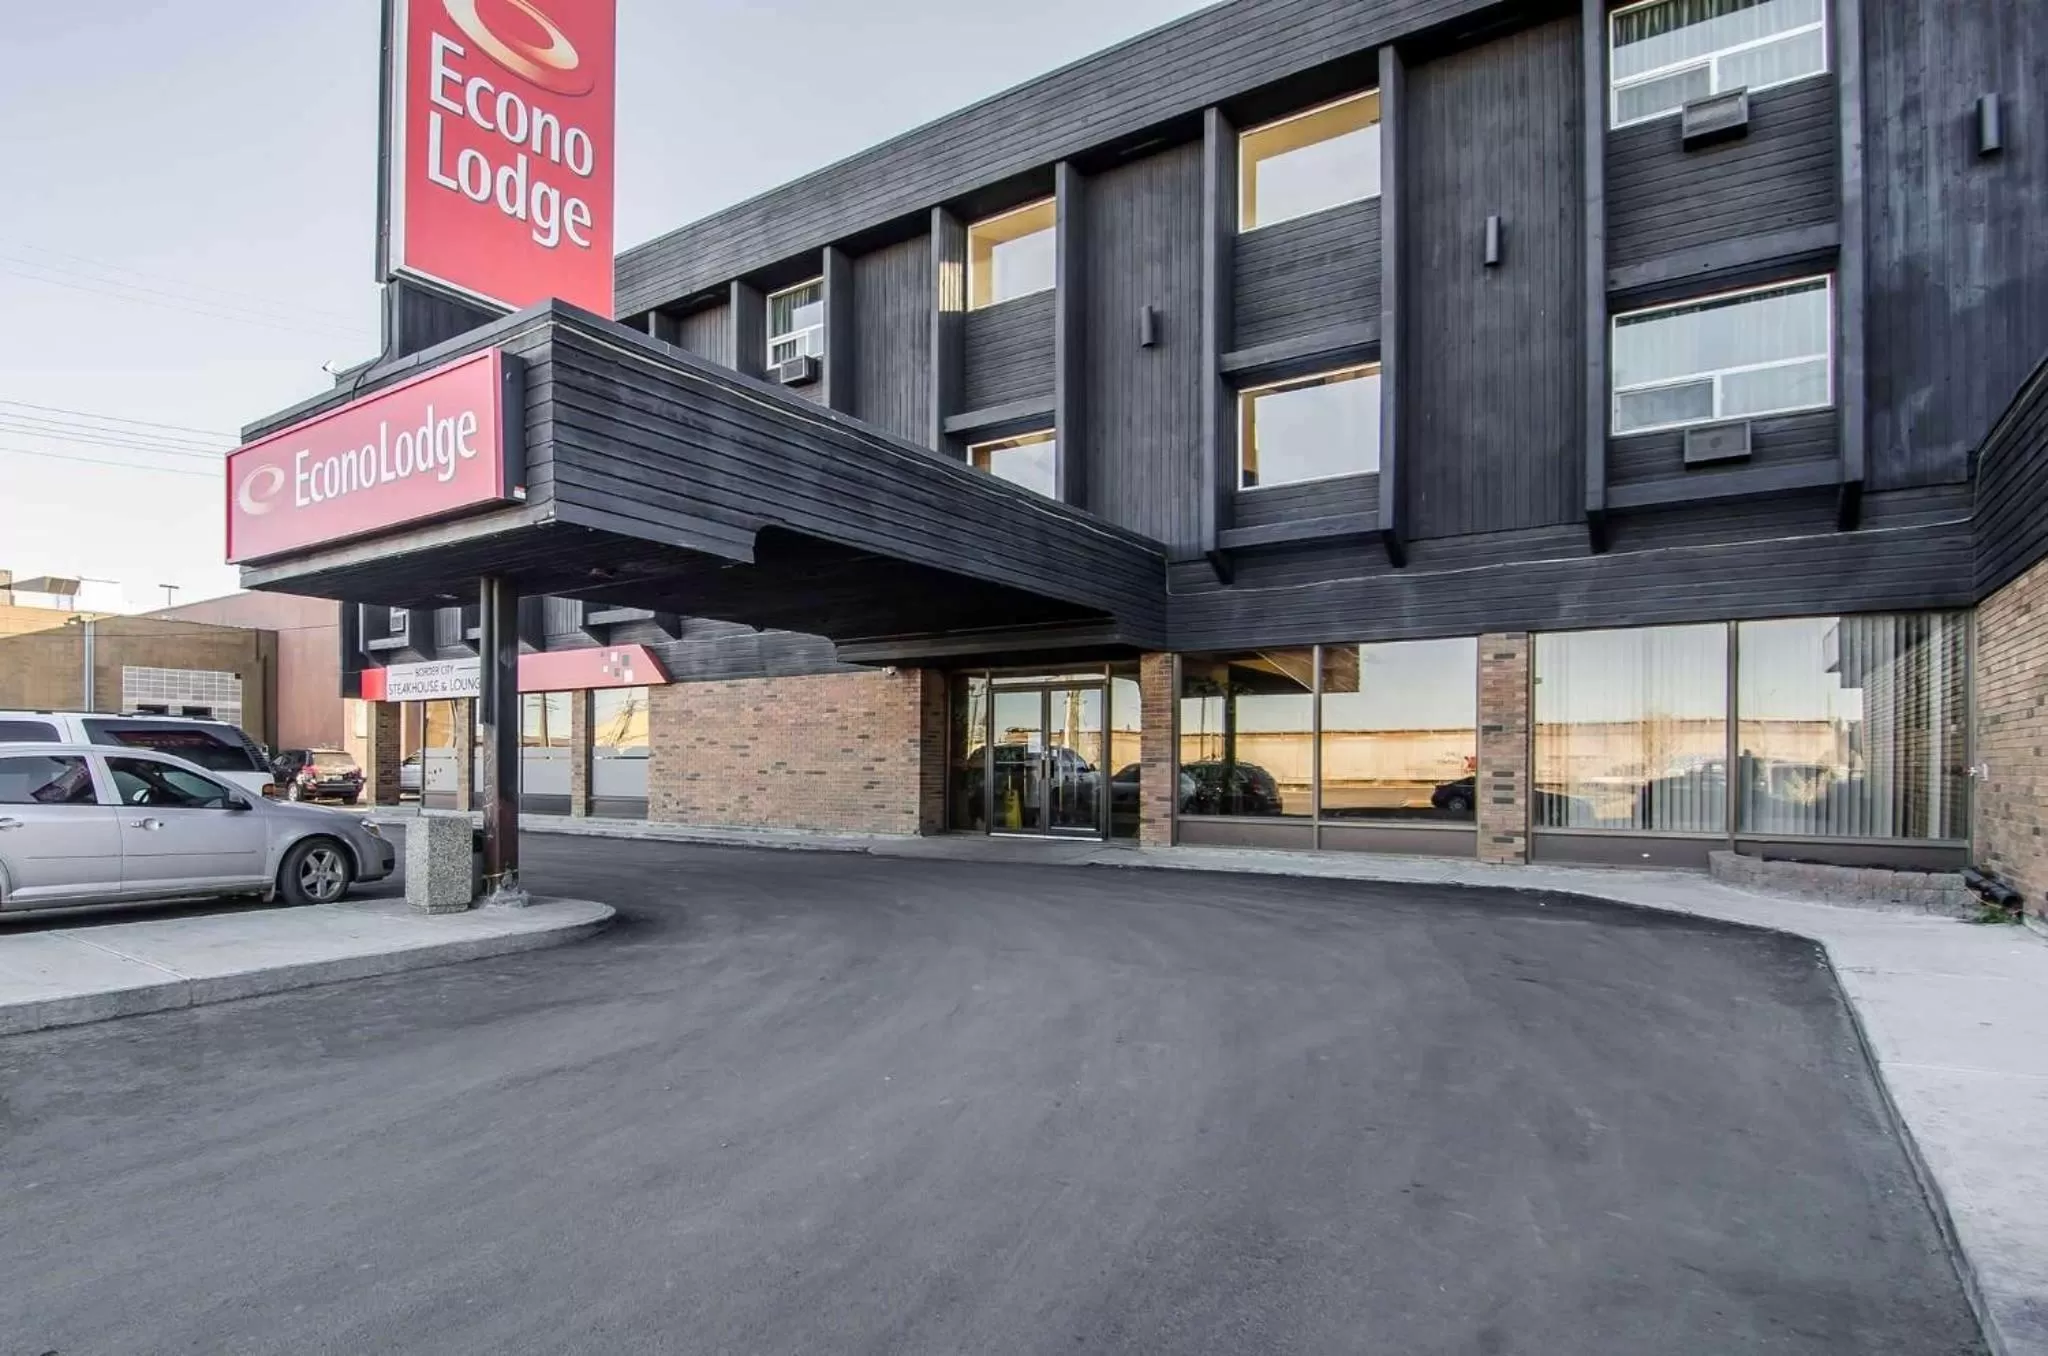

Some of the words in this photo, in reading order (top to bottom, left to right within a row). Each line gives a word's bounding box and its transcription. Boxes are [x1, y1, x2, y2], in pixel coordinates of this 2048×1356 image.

[430, 31, 594, 177] Econo
[428, 110, 593, 248] Lodge
[295, 403, 478, 508] EconoLodge
[388, 679, 439, 696] STEAKHOUSE
[440, 681, 448, 691] &
[450, 677, 480, 692] LOUNG
[415, 666, 439, 677] BORDER
[440, 664, 454, 676] CITY
